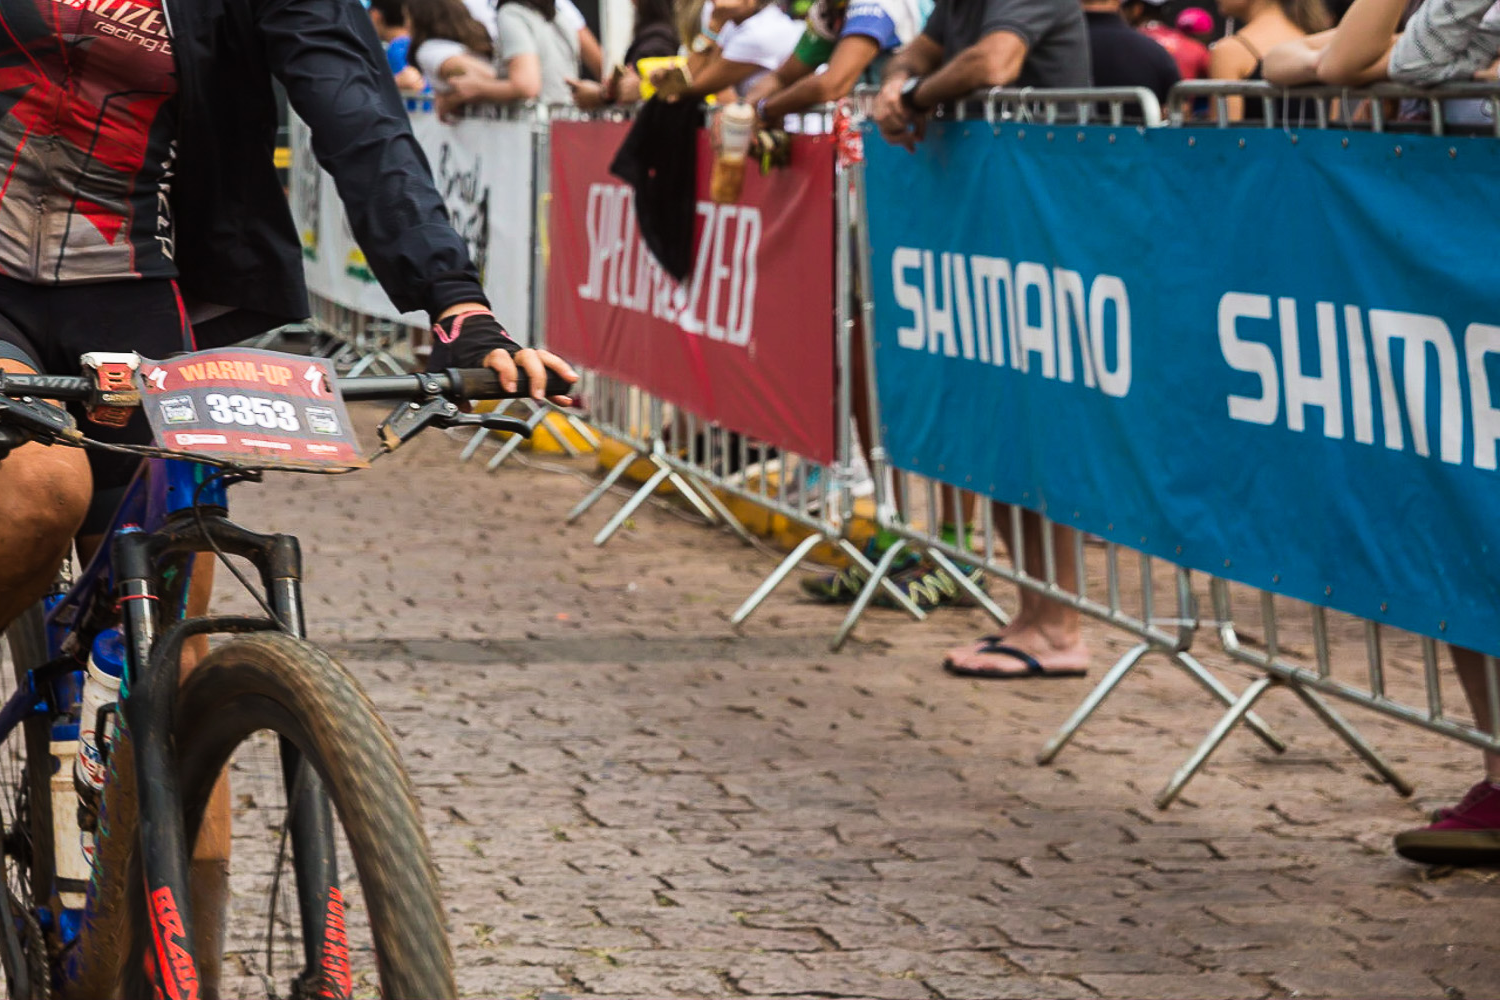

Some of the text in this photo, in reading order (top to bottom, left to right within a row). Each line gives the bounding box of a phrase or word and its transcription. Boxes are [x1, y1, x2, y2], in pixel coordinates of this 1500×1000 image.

[891, 246, 1132, 398] SHIMANO
[177, 359, 294, 386] WARM-UP
[205, 392, 300, 432] 3353
